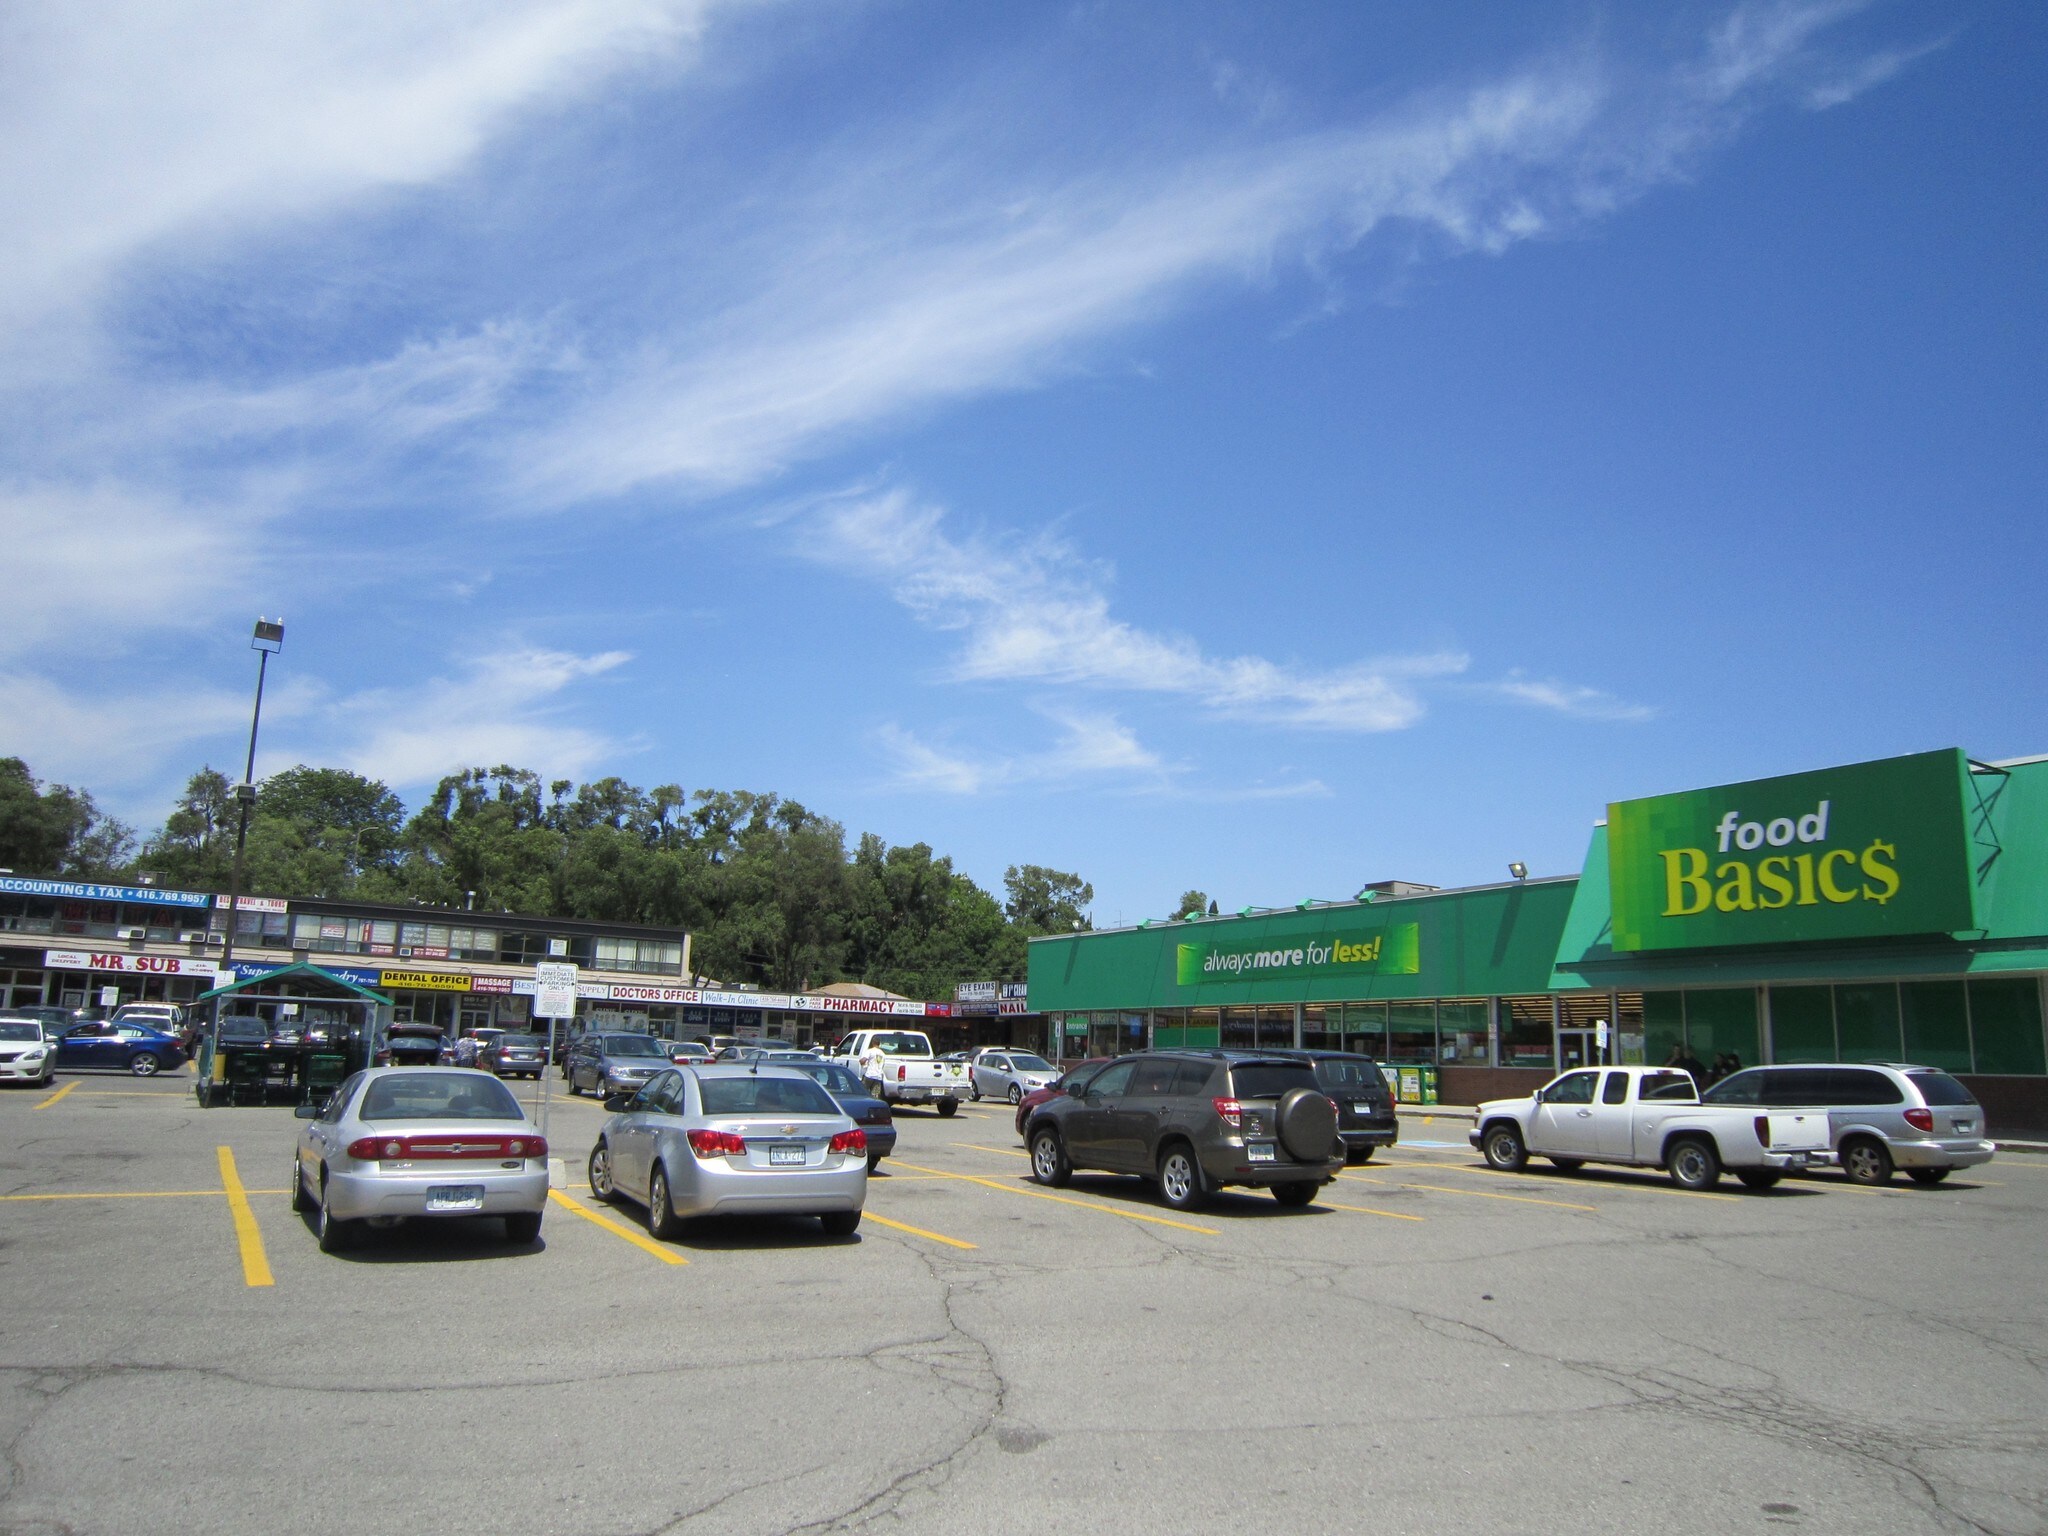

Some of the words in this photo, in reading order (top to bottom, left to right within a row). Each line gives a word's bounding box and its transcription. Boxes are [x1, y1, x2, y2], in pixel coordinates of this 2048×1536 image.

[1715, 800, 1830, 853] food
[0, 880, 84, 896] ACCOUNTING
[86, 886, 95, 896] &
[98, 887, 123, 898] TAX
[136, 890, 206, 903] 416.769.9957
[1203, 949, 1252, 974] always
[1253, 948, 1303, 968] more
[1306, 941, 1332, 965] for
[1332, 936, 1381, 963] less!
[136, 957, 181, 973] SUB
[384, 973, 427, 983] DENTAL
[431, 975, 469, 984] OFFICE
[477, 977, 512, 987] MASSAGE
[613, 987, 661, 999] DOCTORS
[663, 989, 698, 1001] OFFICE
[960, 984, 971, 992] EYE
[973, 982, 995, 991] EXAMS
[704, 992, 735, 1003] Walk-In
[737, 994, 759, 1005] Clinic
[824, 998, 895, 1012] PHARMACY
[1066, 1022, 1088, 1030] Entrance
